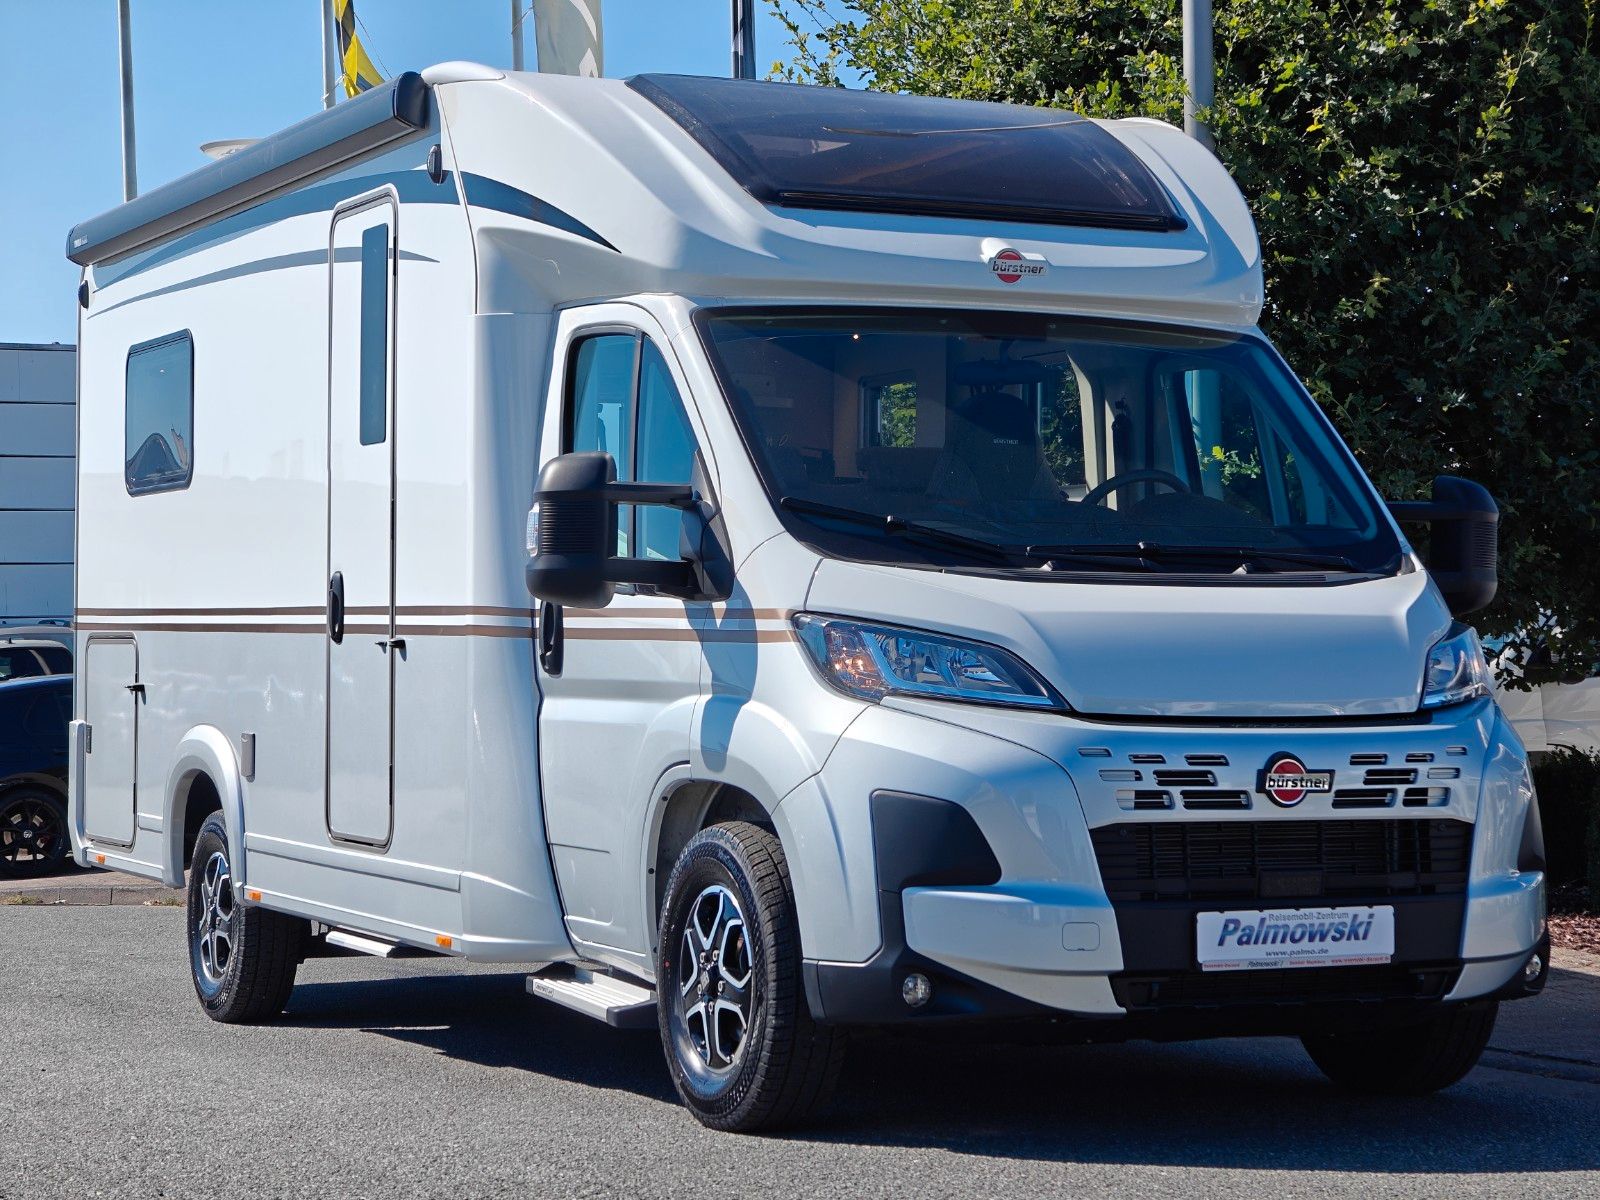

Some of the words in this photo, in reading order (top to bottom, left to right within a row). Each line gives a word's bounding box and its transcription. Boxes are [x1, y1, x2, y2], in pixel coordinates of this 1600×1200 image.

[992, 261, 1044, 274] bürstner
[1267, 775, 1329, 788] bürstner
[1268, 912, 1350, 922] Reisemobil-Zentrum
[1217, 913, 1375, 947] Palmowski
[1265, 948, 1329, 959] www.palmo.de
